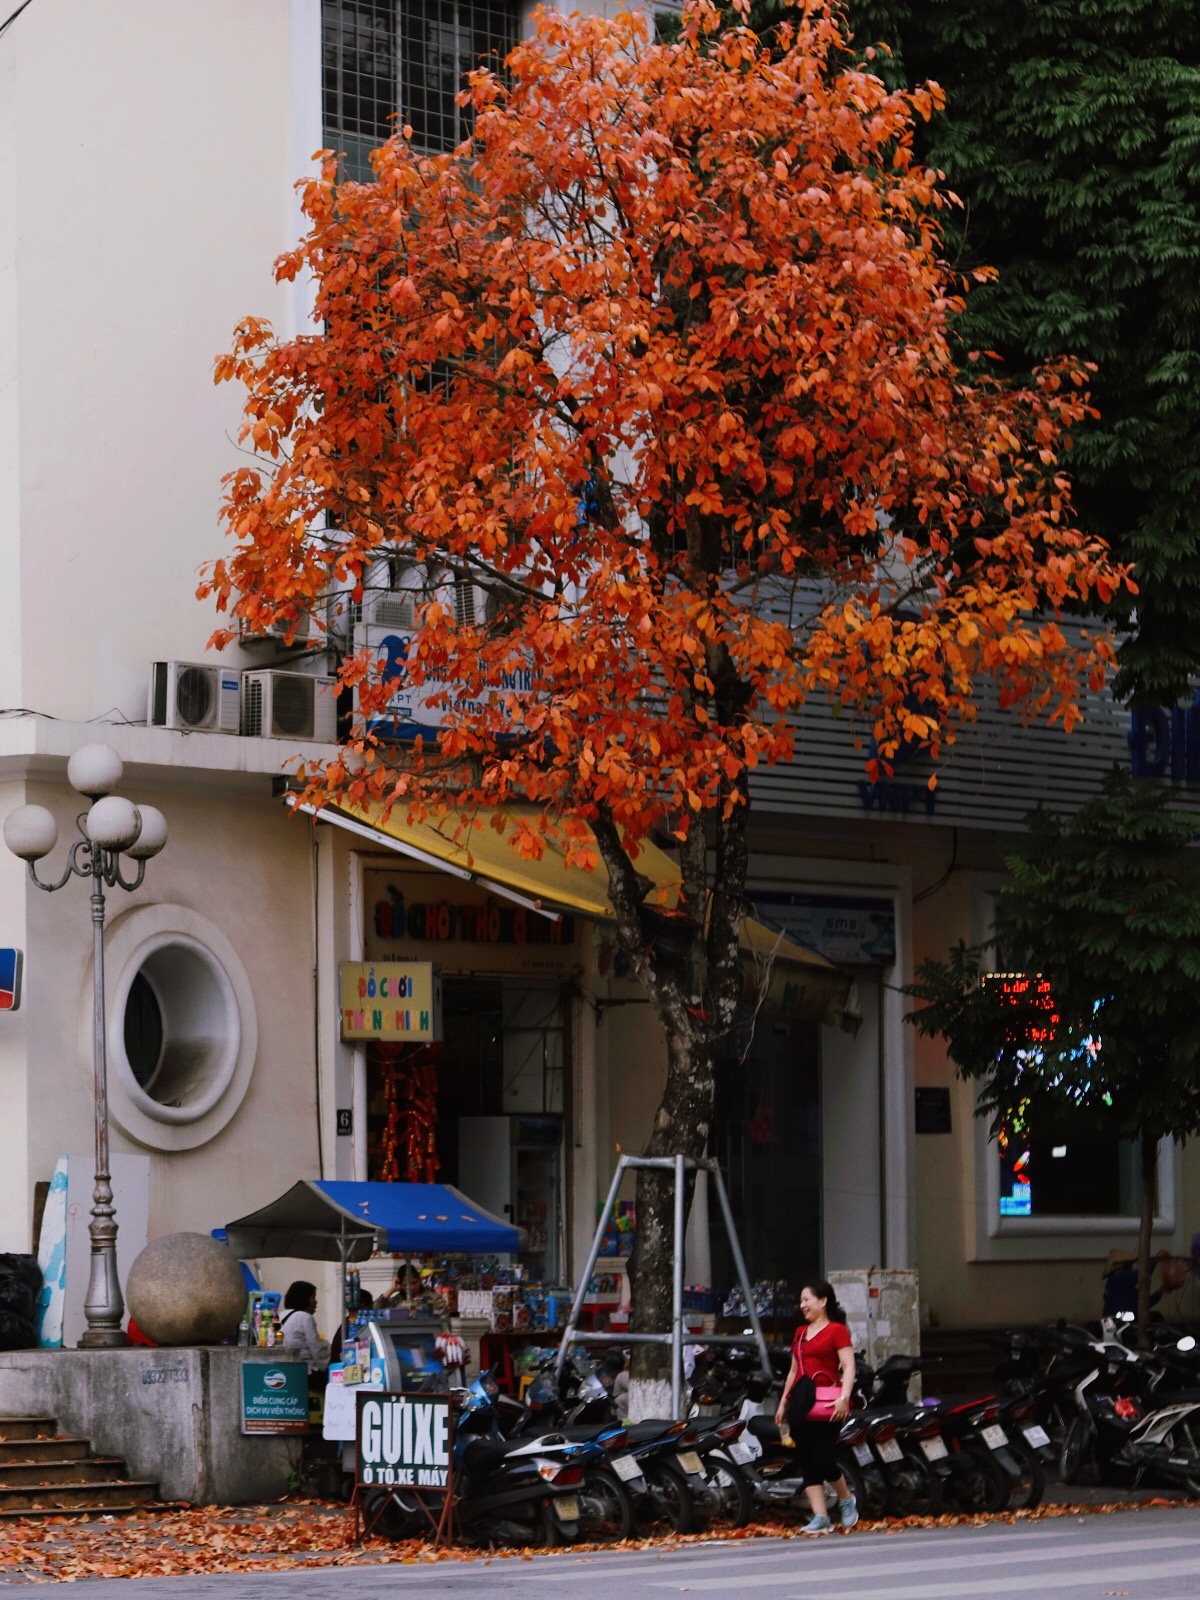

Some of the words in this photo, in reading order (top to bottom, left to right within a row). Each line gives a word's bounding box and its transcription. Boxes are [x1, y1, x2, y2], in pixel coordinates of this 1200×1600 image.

[379, 975, 413, 999] CHƠI
[395, 1009, 429, 1031] MINH
[340, 1112, 349, 1127] 6
[418, 1466, 448, 1487] MÁY
